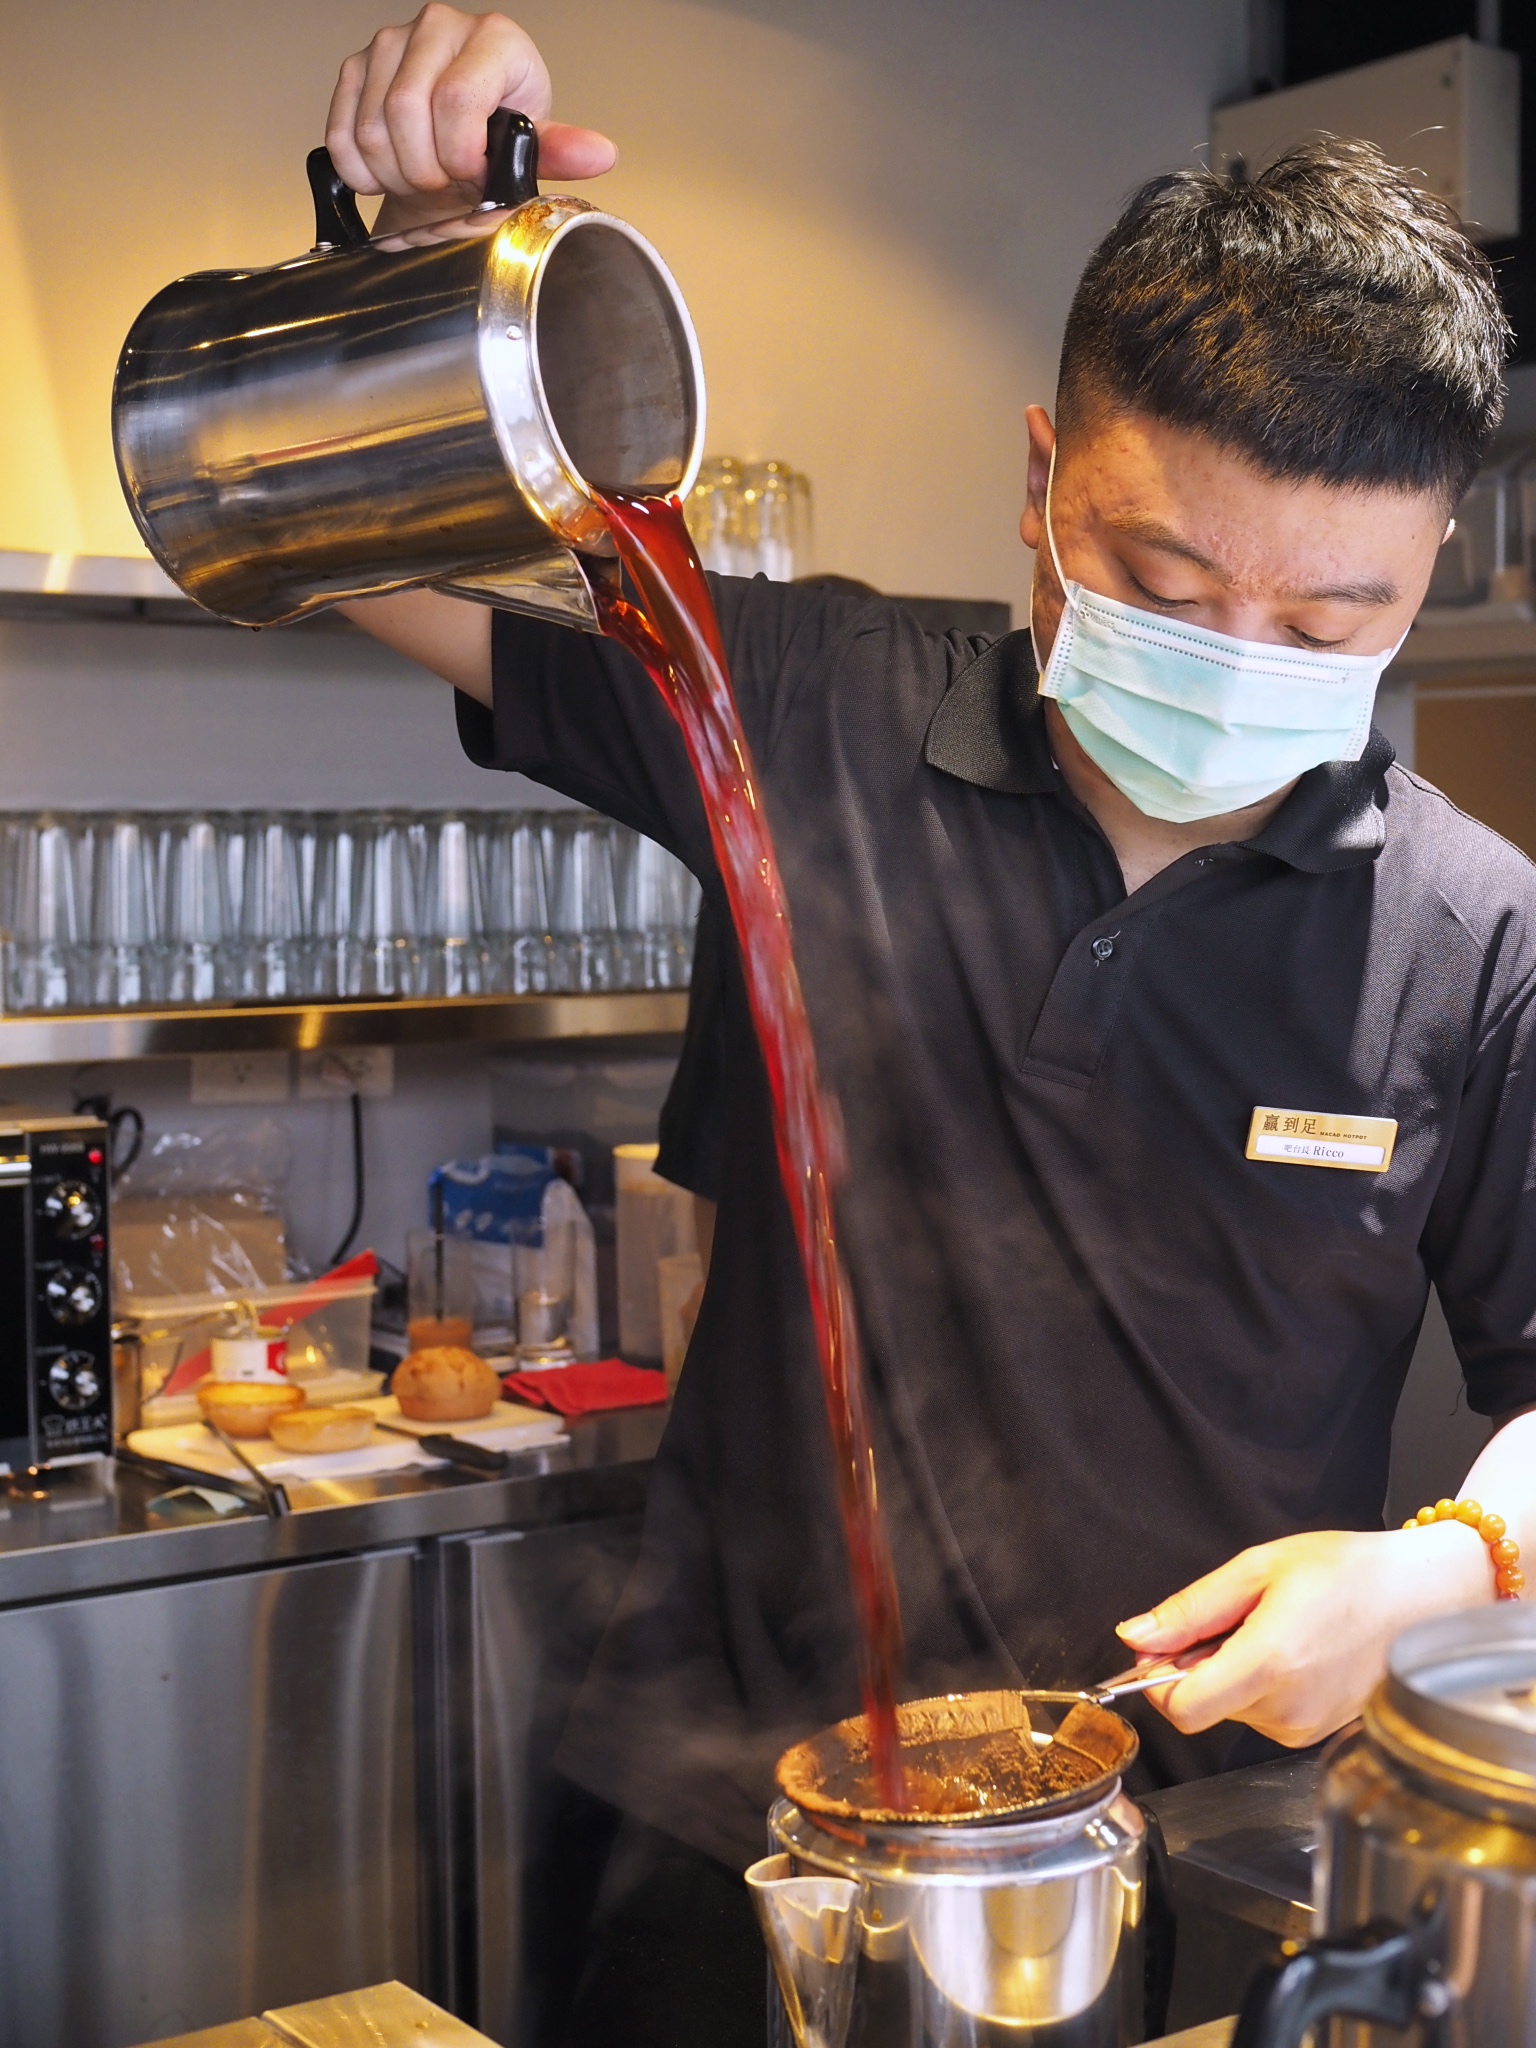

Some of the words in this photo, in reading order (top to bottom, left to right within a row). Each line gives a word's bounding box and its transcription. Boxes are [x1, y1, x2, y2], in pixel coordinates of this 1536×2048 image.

[1262, 1114, 1316, 1135] 贏到足
[1313, 1145, 1344, 1158] Ricco
